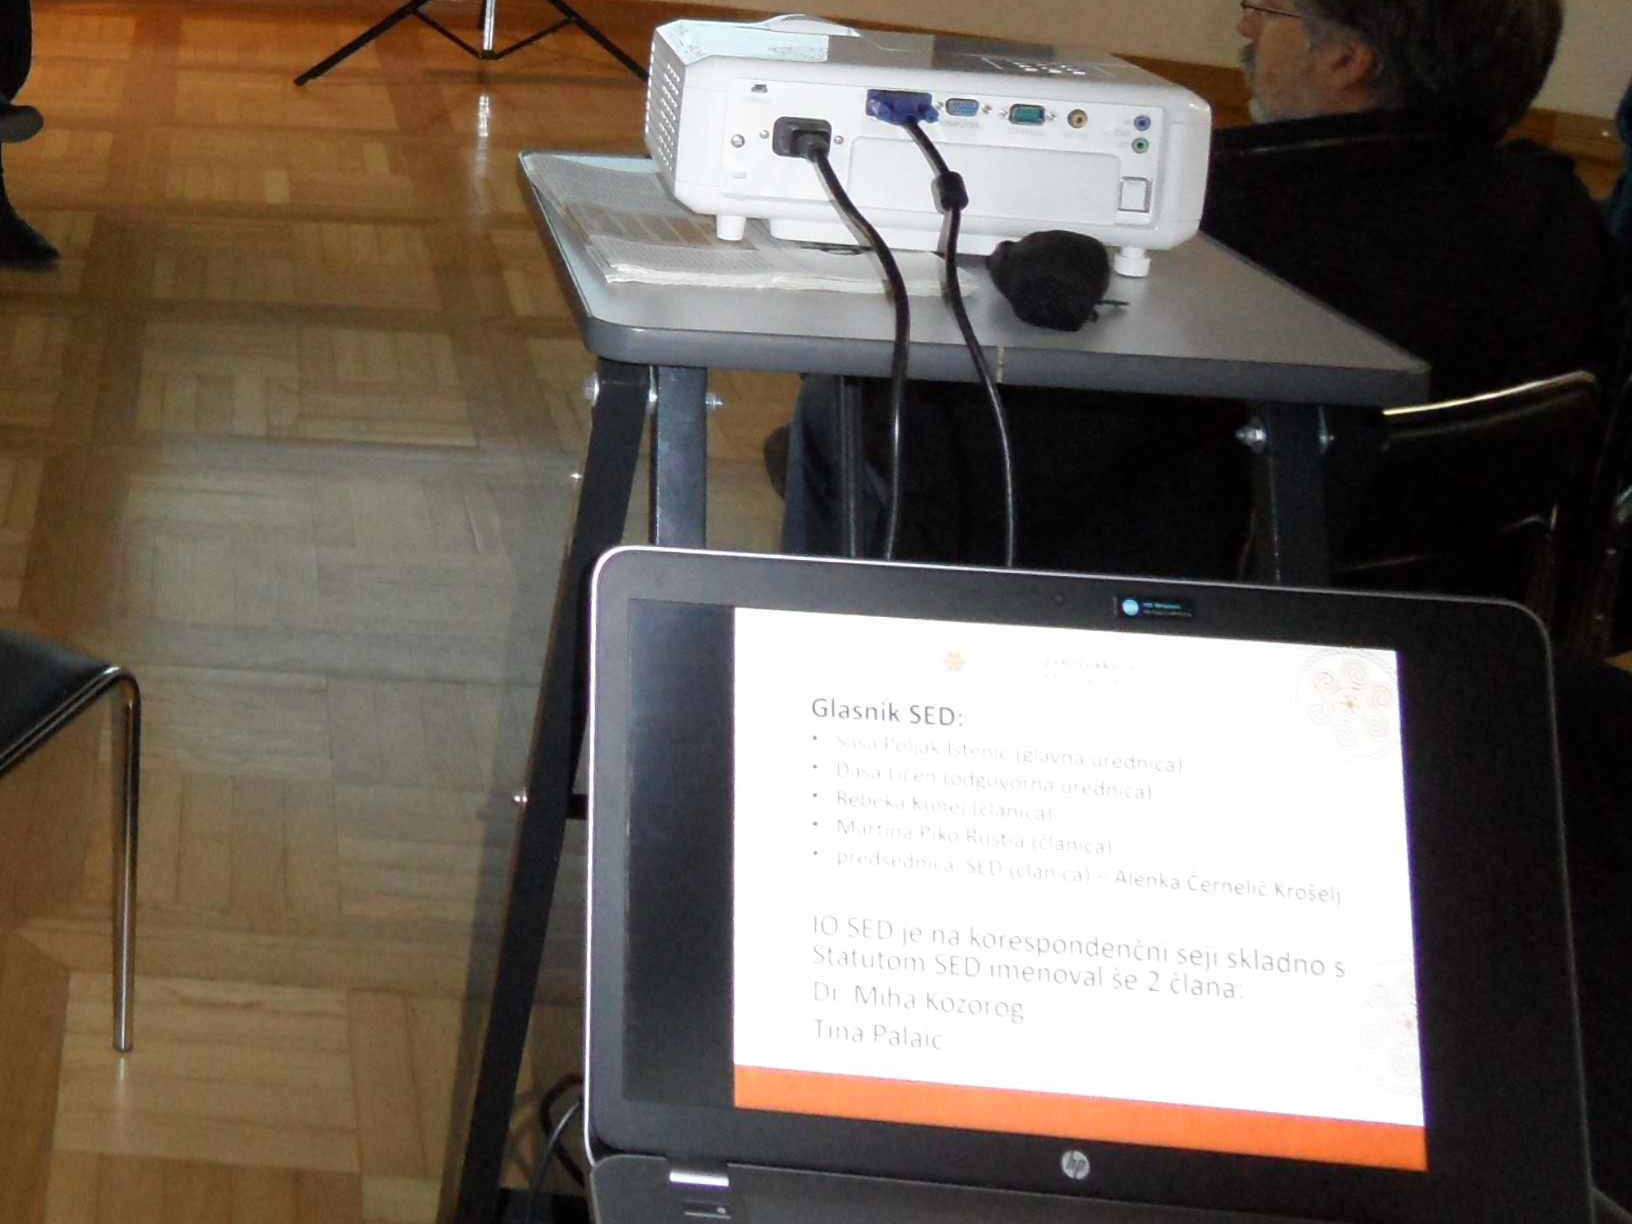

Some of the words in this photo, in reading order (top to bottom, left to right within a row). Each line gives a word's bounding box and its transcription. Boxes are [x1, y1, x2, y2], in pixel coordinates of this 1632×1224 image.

[811, 698, 901, 722] Glasnik
[909, 704, 964, 727] SED:
[837, 790, 905, 811] Rebeka
[837, 818, 912, 840] Martina
[920, 824, 959, 843] Piko
[967, 828, 1024, 849] Rustia
[837, 850, 955, 873] predsednica
[966, 858, 1003, 877] SED
[1115, 869, 1180, 890] Alenka
[1274, 881, 1342, 908] Krošelj
[813, 915, 839, 936] IO
[847, 917, 893, 940] SED
[901, 923, 923, 947] je
[932, 927, 961, 947] na
[970, 926, 1168, 963] korespondenčni
[1176, 944, 1218, 972] seji
[1227, 947, 1326, 977] skladno
[1334, 959, 1346, 979] s
[813, 943, 925, 973] Statutom
[934, 953, 980, 977] SED
[990, 958, 1103, 987] imenoval
[1112, 967, 1138, 991] še
[1148, 971, 1160, 992] 2
[854, 984, 916, 1009] Miha
[926, 991, 1024, 1024] Kozorog
[814, 1018, 864, 1043] Tina
